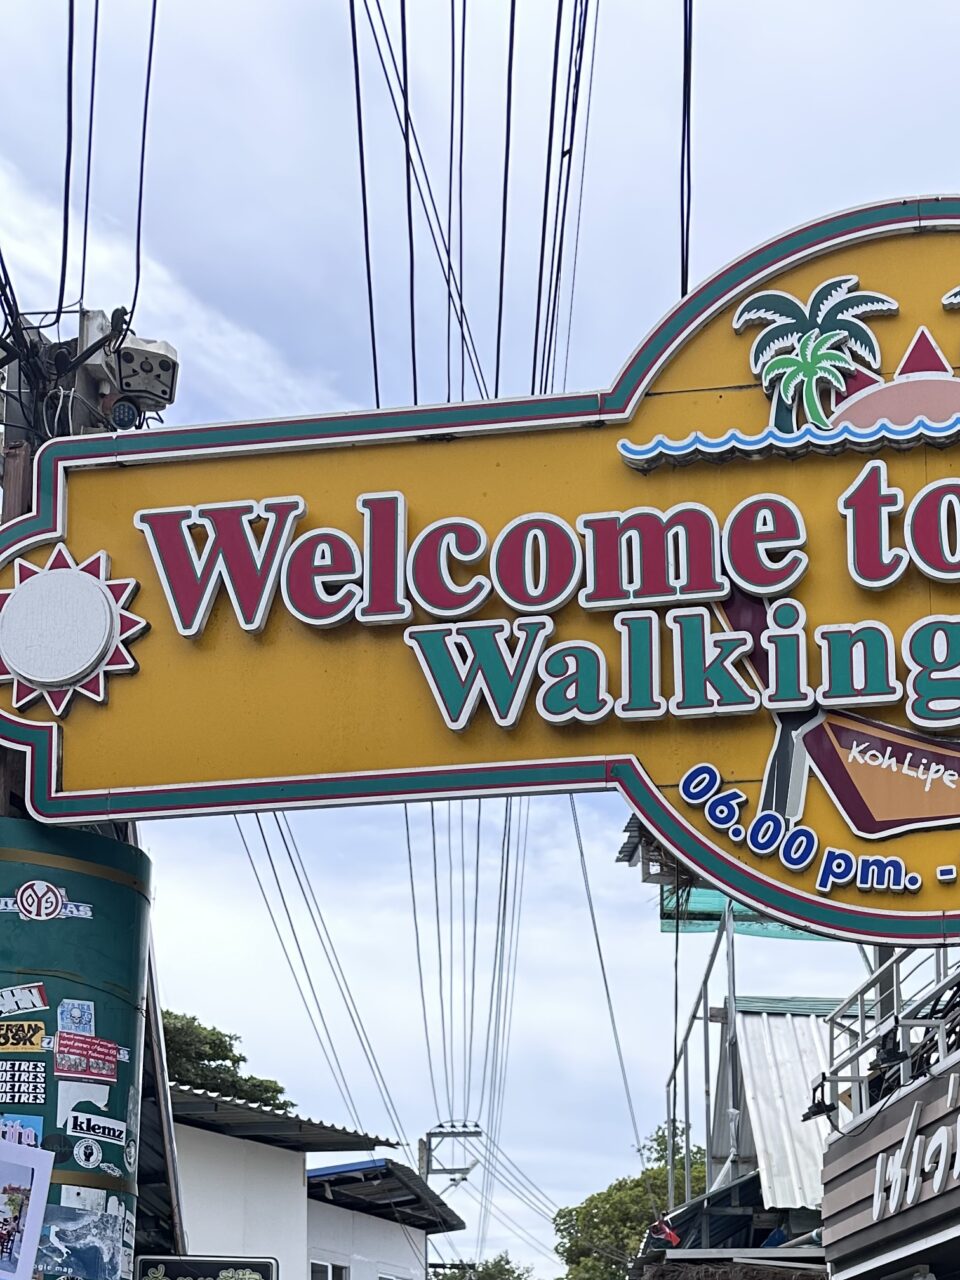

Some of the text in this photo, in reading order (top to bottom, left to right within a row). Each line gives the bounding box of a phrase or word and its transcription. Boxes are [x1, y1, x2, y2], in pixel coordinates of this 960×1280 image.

[134, 491, 809, 638] Welcome
[846, 738, 960, 792] Koh Lipe
[678, 761, 820, 872] 06.00
[816, 848, 922, 894] pm.
[71, 1115, 124, 1139] klemz
